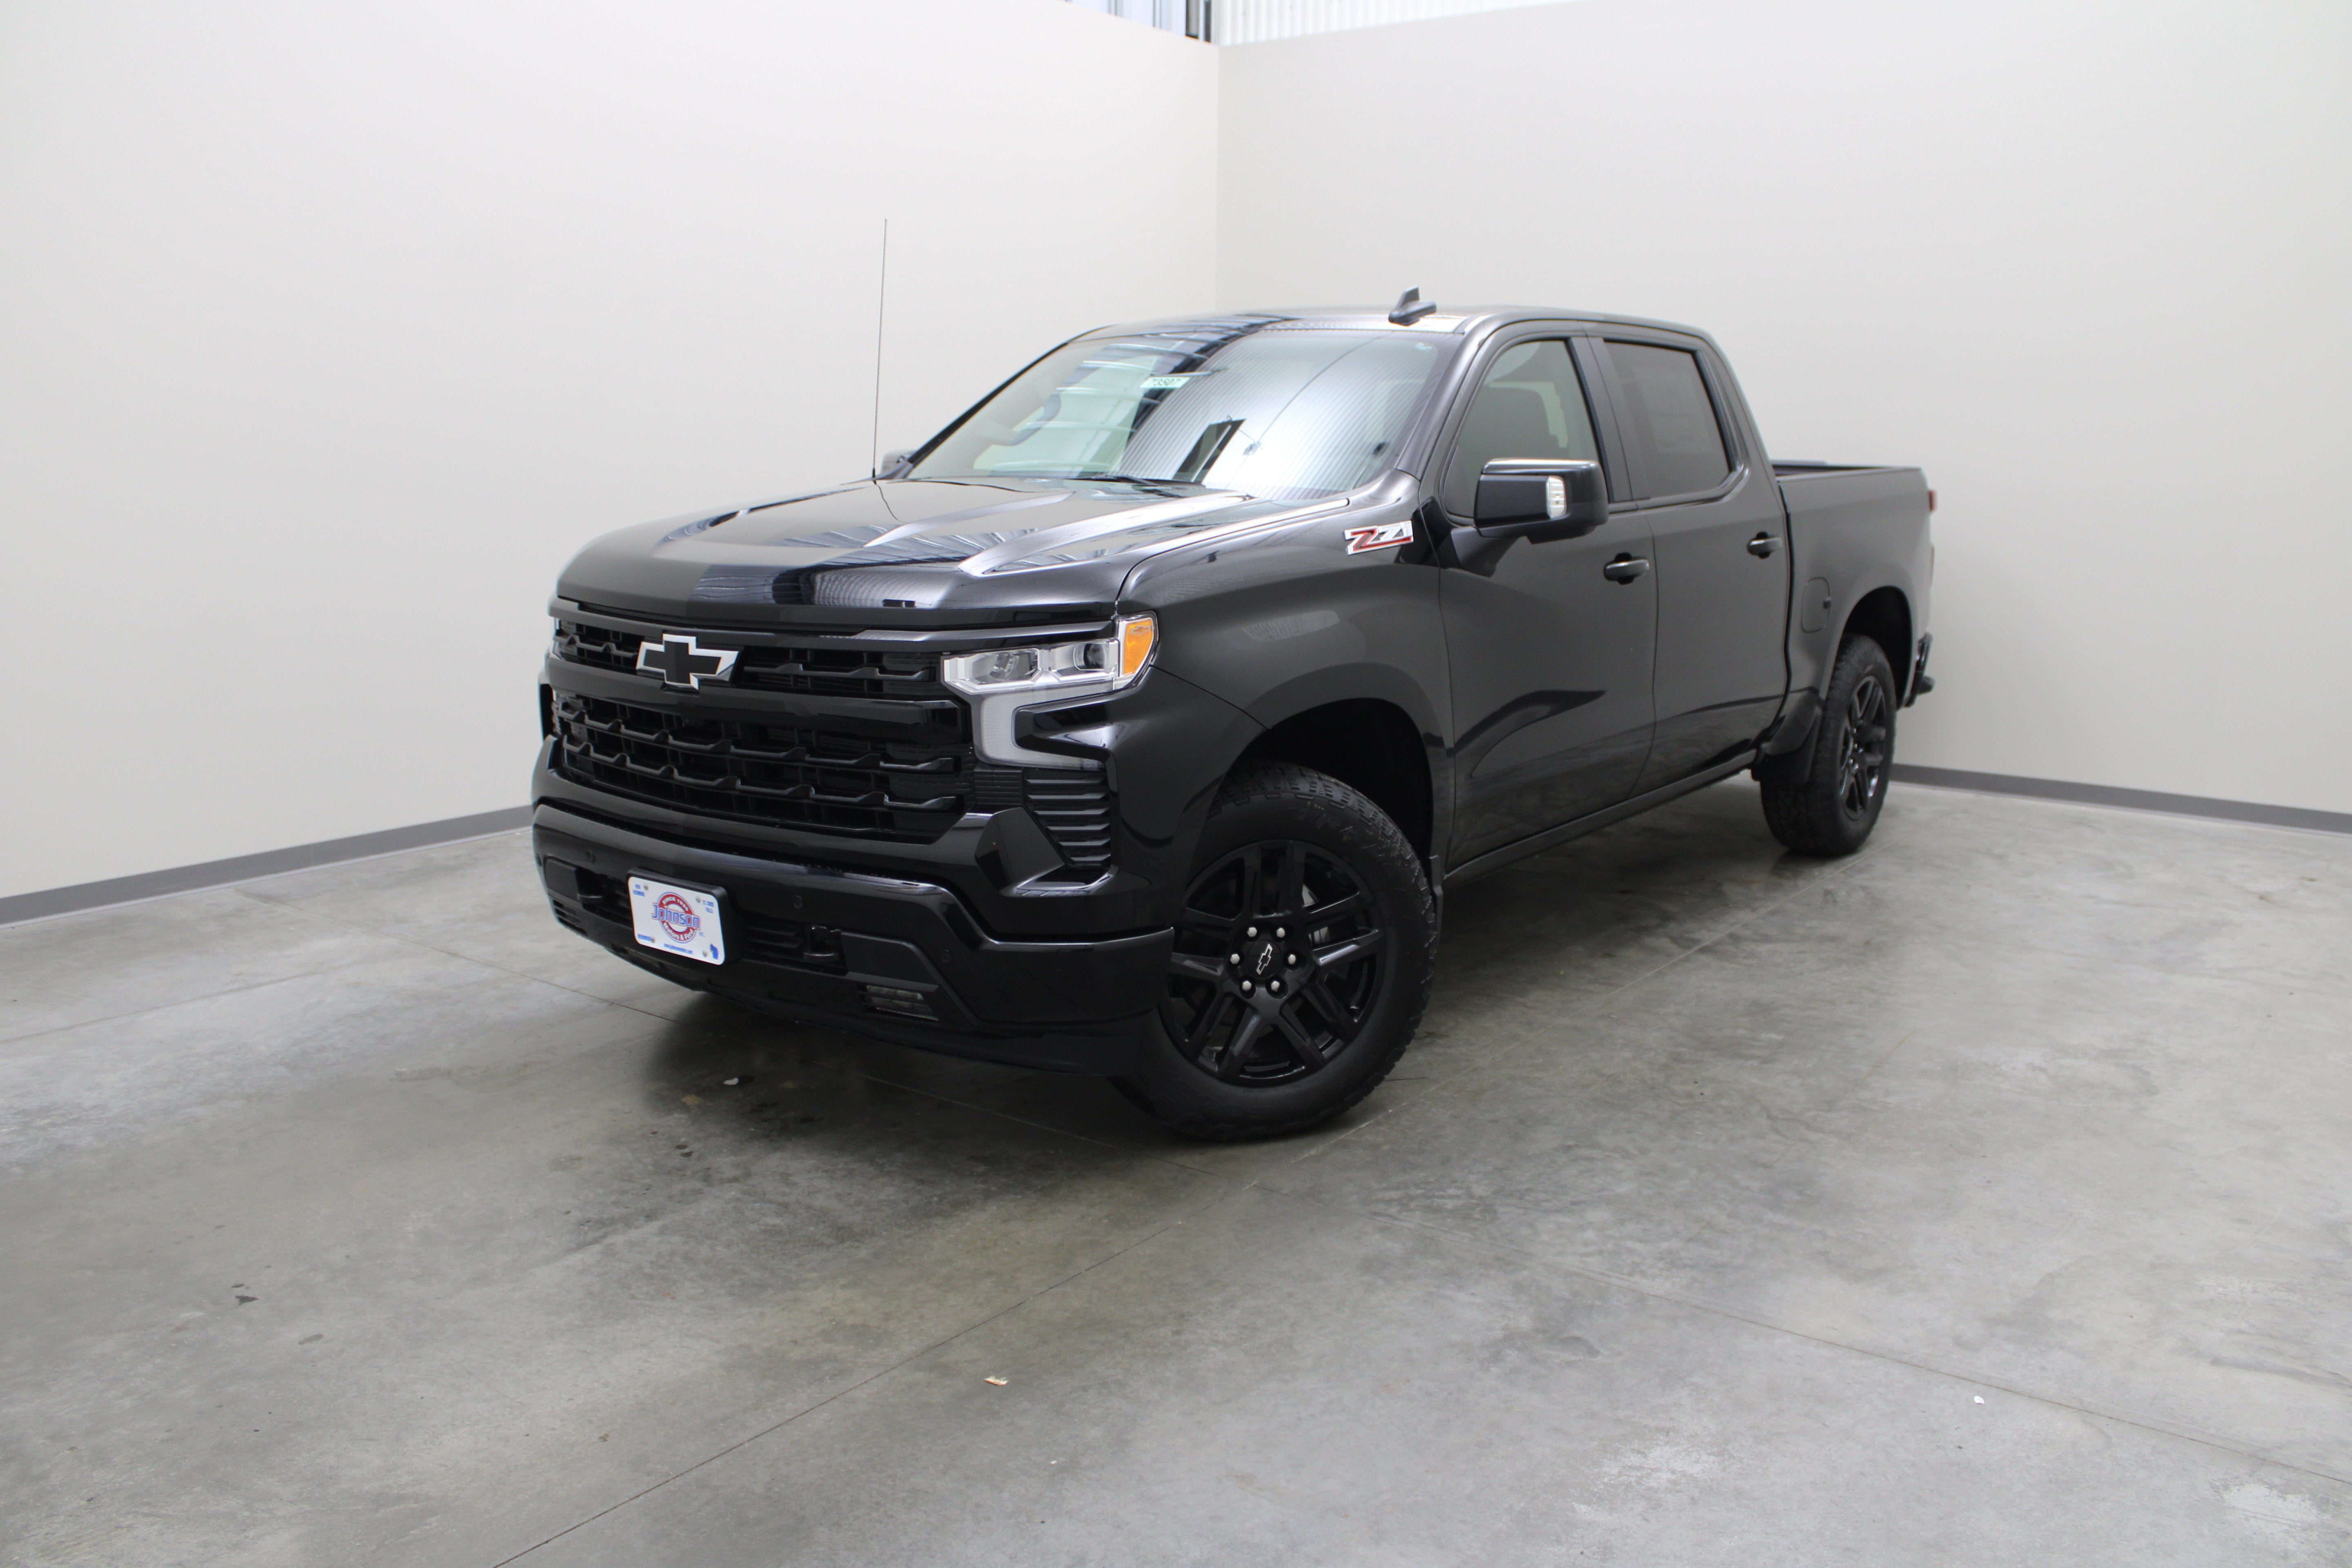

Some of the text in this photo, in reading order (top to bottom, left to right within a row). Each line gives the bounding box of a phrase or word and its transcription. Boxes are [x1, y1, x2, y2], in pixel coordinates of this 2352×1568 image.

[1344, 520, 1414, 556] Z71
[662, 896, 676, 904] SINCE
[652, 903, 700, 930] Johnson
[663, 922, 680, 940] Motors
